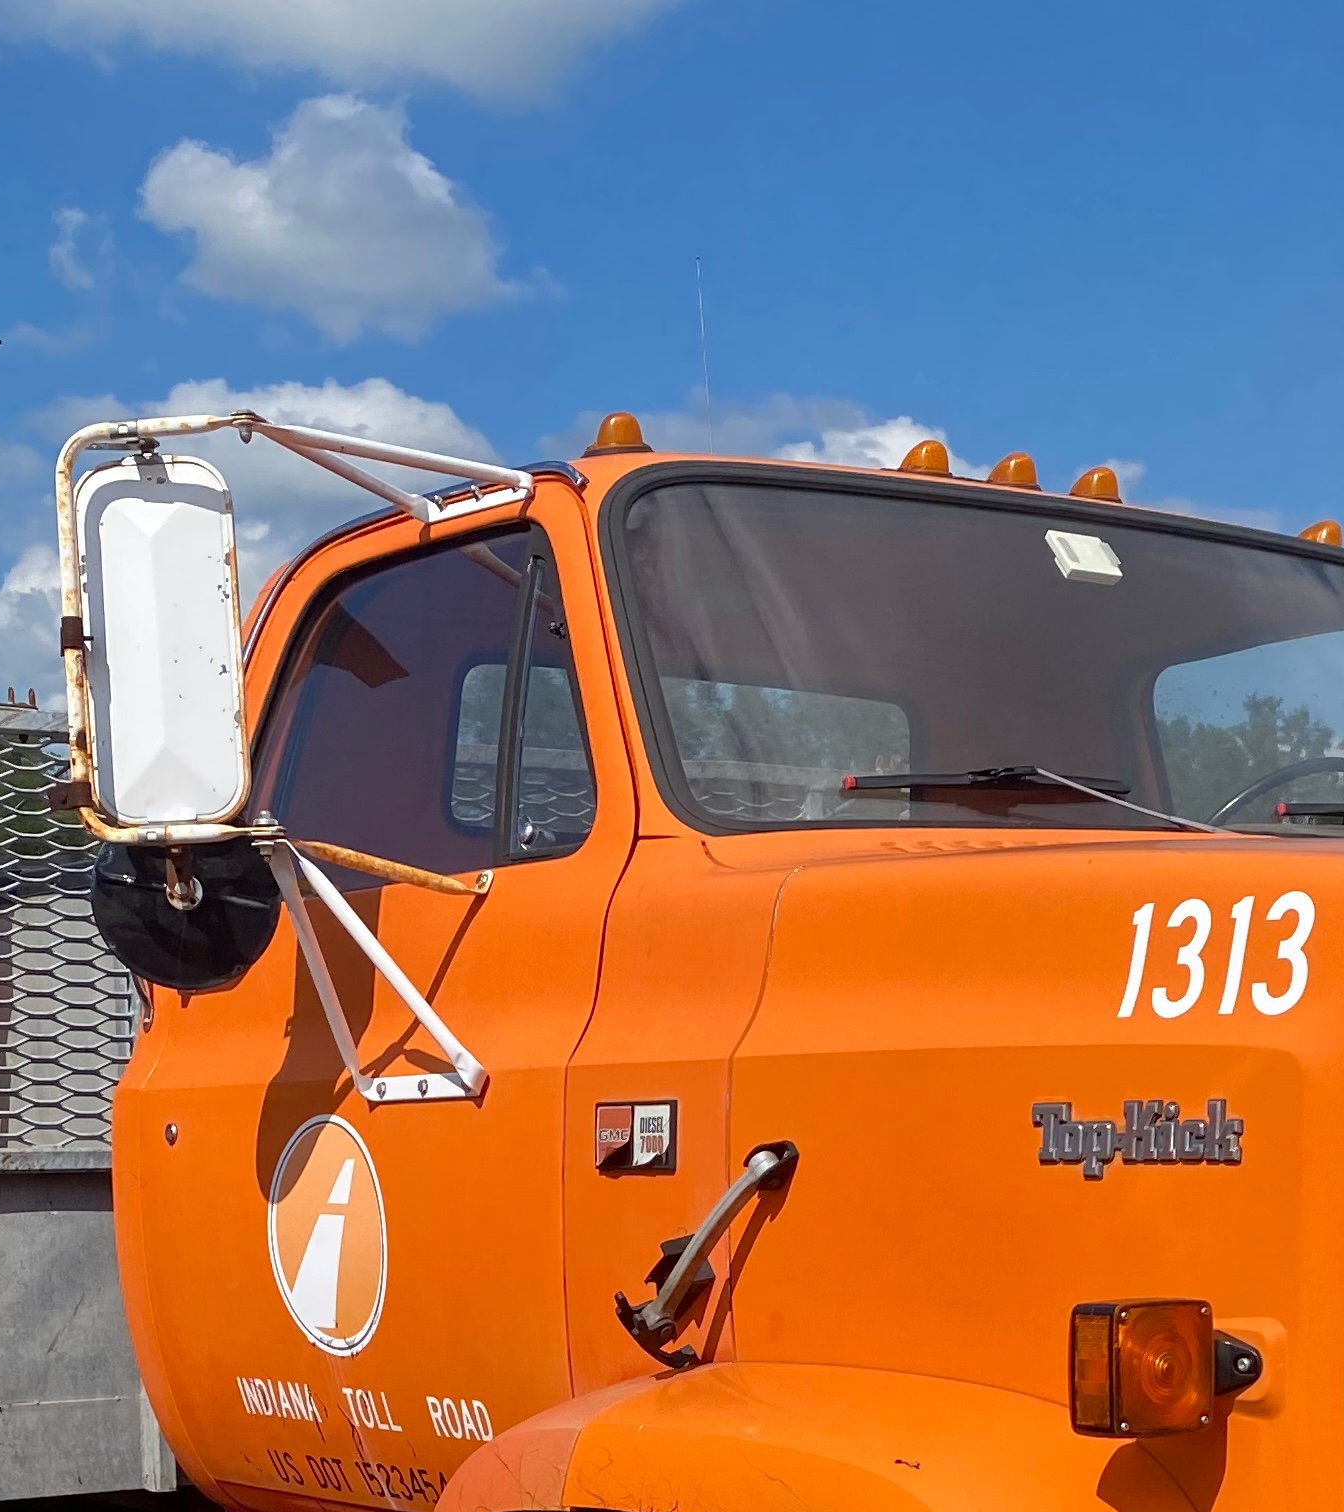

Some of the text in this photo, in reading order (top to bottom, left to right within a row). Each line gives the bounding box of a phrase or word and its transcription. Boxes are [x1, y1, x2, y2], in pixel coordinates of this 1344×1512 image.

[1117, 891, 1316, 1018] 1313
[599, 1129, 630, 1142] GMC
[639, 1116, 664, 1134] DIESEL
[640, 1135, 664, 1154] 7000
[1032, 1100, 1243, 1180] TopKick
[236, 1376, 494, 1442] INDIANA TOLL ROAD
[267, 1449, 304, 1486] US
[306, 1454, 353, 1493] DOT
